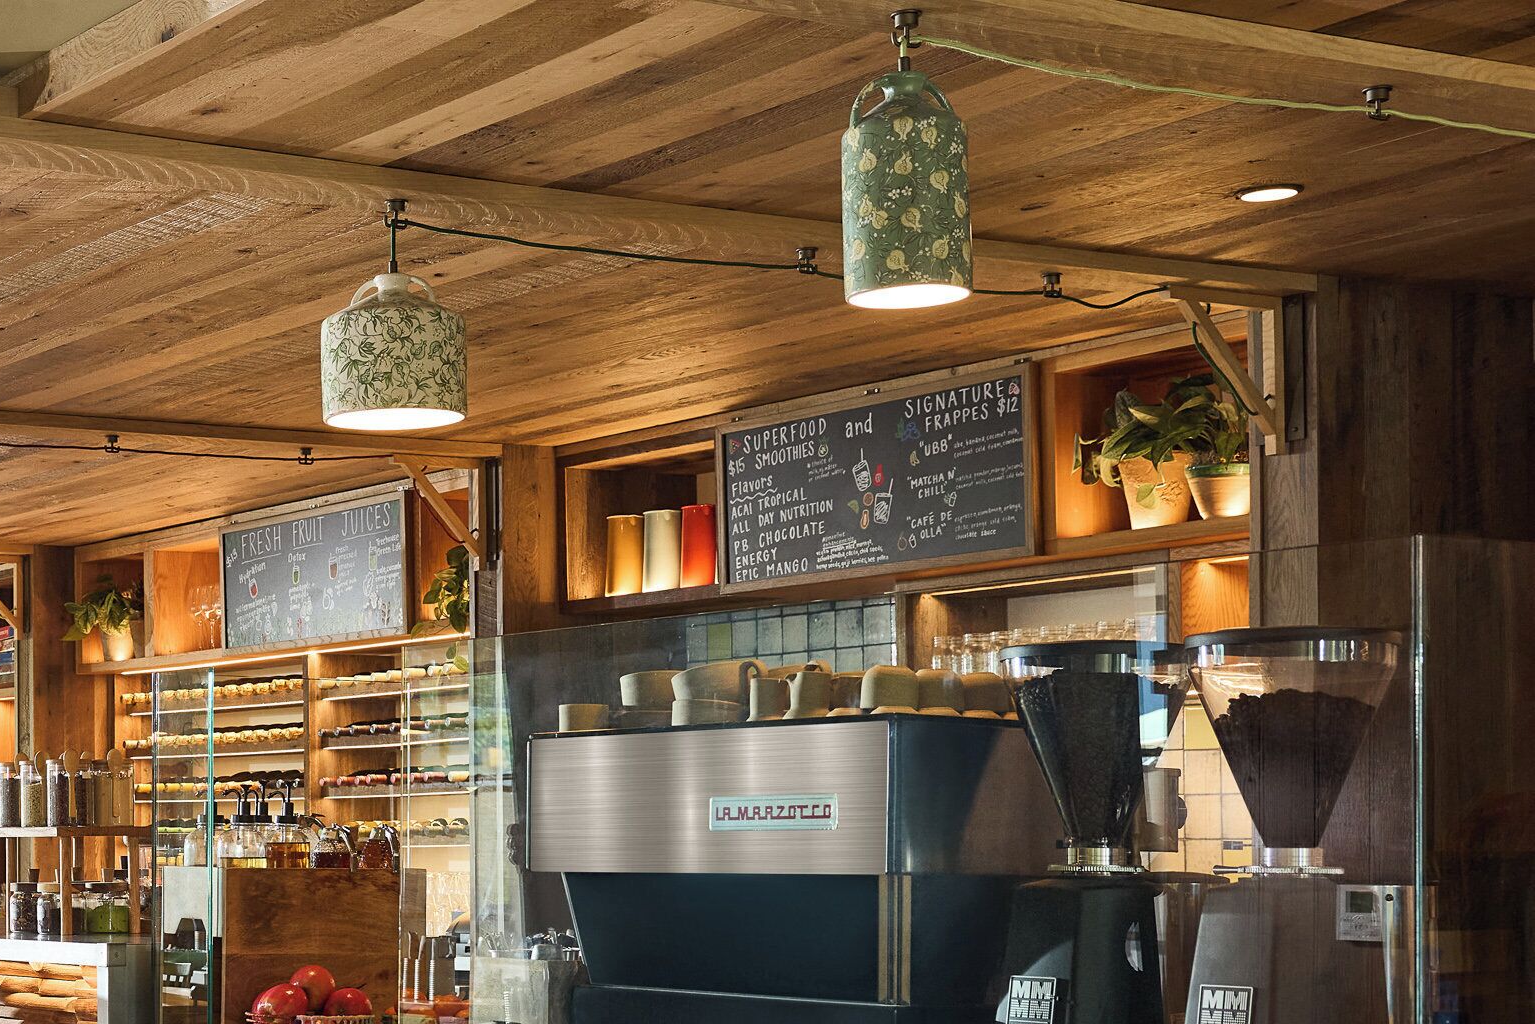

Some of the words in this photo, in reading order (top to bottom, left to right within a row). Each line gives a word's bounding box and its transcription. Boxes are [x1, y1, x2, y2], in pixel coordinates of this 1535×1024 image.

[905, 380, 1005, 418] SIGNATURE
[925, 403, 989, 432] FRAPPES
[997, 396, 1019, 417] $12
[743, 418, 827, 454] SUPERFOOD
[845, 412, 873, 438] and
[728, 457, 745, 477] $15
[755, 440, 815, 470] SMOOTHIES
[731, 475, 773, 498] Flavors
[731, 502, 753, 520] ACAI
[758, 487, 807, 511] TROPICAL
[731, 520, 751, 536] ALL
[758, 512, 775, 527] DAY
[780, 499, 834, 522] NUTRITION
[940, 510, 953, 521] DE
[241, 525, 282, 559] FRESH
[292, 516, 325, 547] FRUIT
[341, 502, 391, 536] JUICES
[734, 539, 749, 555] PB
[759, 521, 825, 548] CHOCOLATE
[735, 547, 778, 569] ENERGY
[735, 567, 759, 582] EPIC
[766, 558, 809, 577] MANGO
